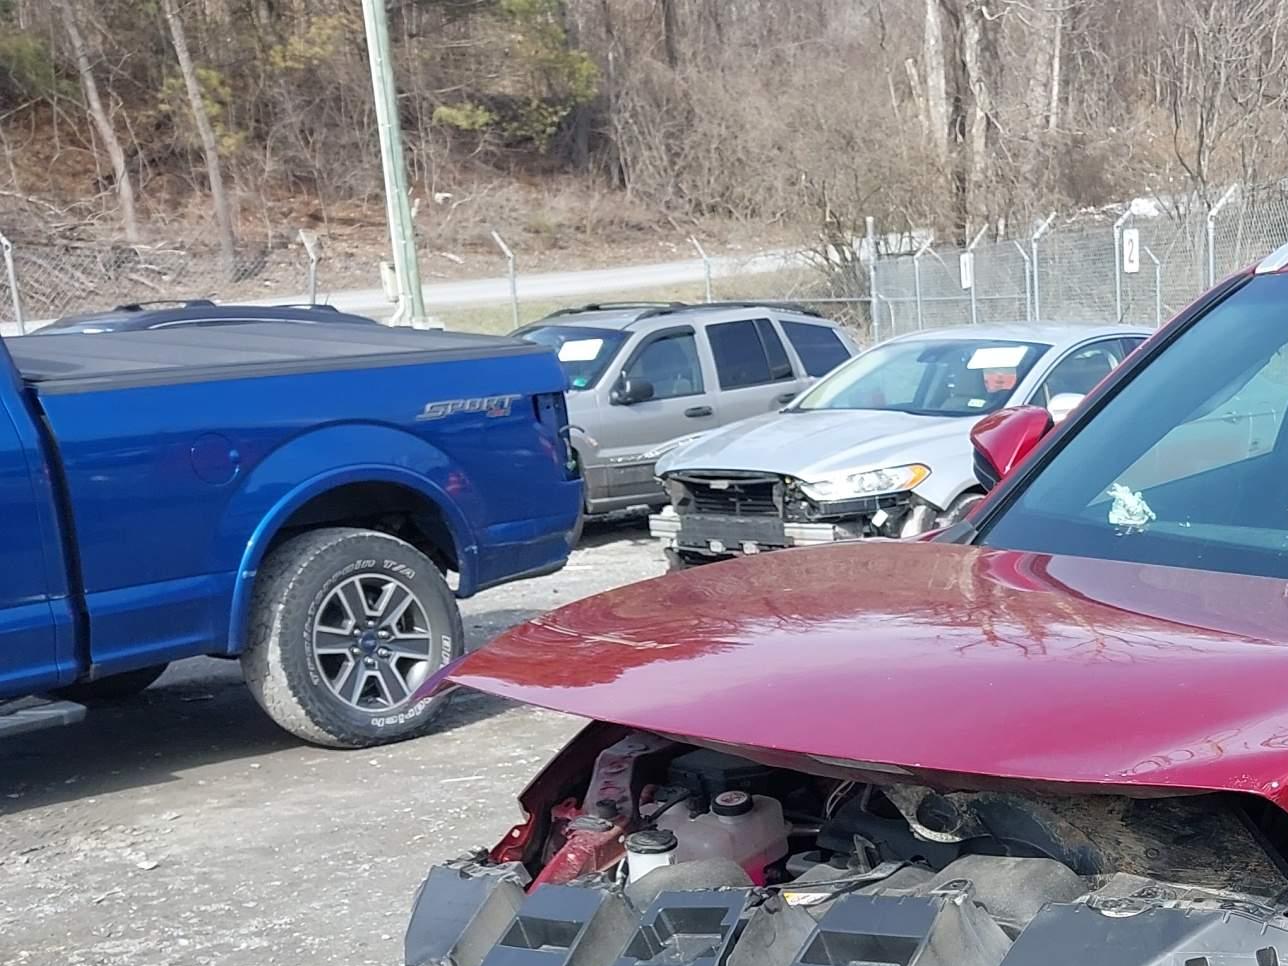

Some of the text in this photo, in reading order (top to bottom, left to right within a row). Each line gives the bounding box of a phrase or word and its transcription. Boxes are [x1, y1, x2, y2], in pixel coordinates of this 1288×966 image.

[1127, 238, 1135, 264] 2
[416, 394, 522, 421] SPORT
[383, 558, 416, 580] T/A
